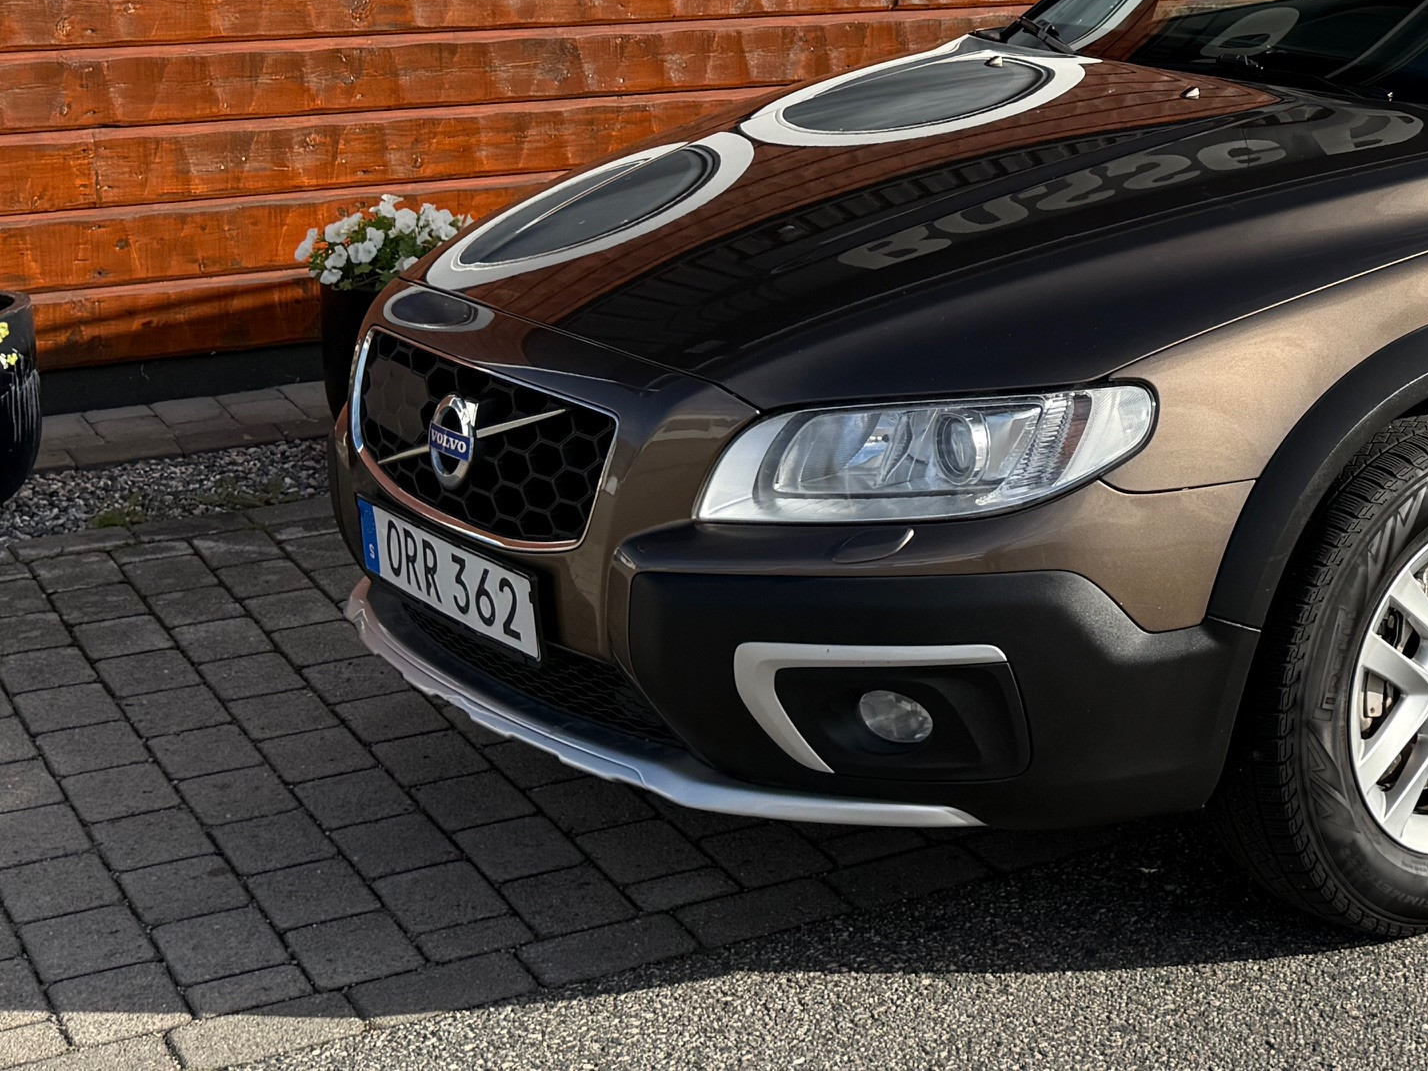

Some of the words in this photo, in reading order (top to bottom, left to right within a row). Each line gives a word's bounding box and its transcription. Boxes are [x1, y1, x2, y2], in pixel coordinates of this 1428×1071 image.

[430, 427, 467, 454] VOLVO
[368, 543, 376, 559] S
[386, 519, 443, 605] ORR
[449, 552, 522, 642] 362
